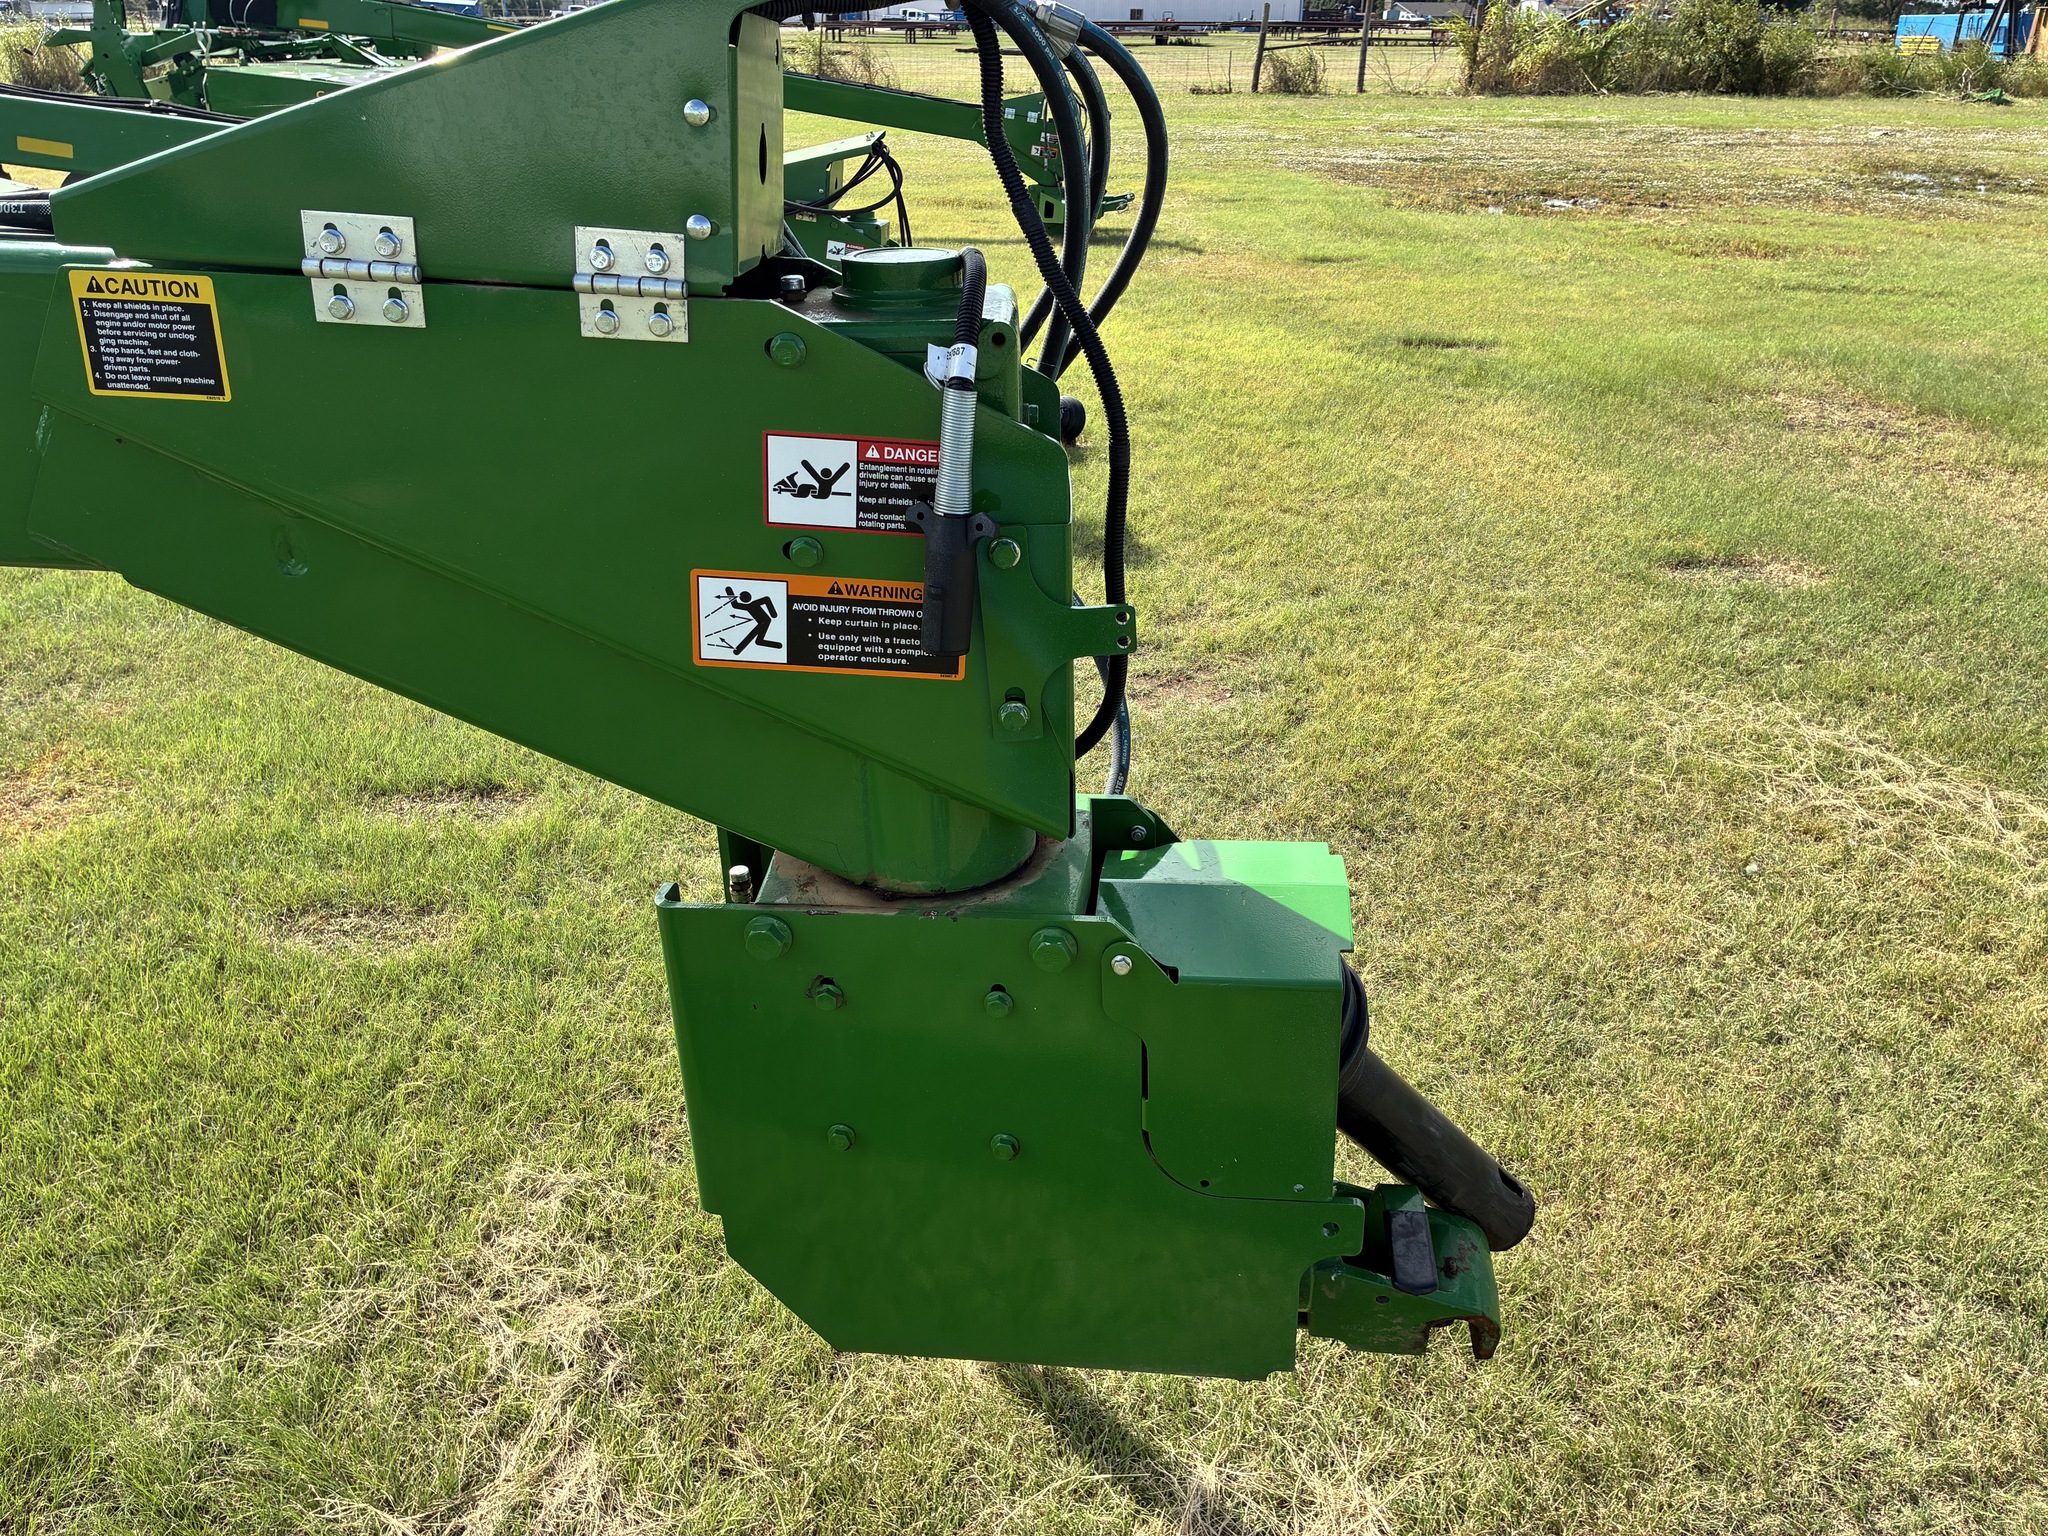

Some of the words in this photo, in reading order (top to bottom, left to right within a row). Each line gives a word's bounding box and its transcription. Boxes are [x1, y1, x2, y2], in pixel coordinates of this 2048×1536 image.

[1031, 26, 1046, 45] 4000
[1045, 47, 1055, 60] psi
[105, 278, 199, 298] CAUTION
[92, 301, 110, 310] Keep
[94, 311, 133, 319] Disengage
[169, 313, 180, 321] off
[96, 320, 121, 328] engine
[123, 320, 146, 328] and/or
[149, 322, 171, 330] motor
[173, 323, 195, 331] power
[98, 328, 121, 336] before
[123, 330, 157, 339] servicing
[169, 331, 197, 341] unclog-
[99, 337, 116, 346] ging
[118, 338, 151, 346] machine.
[100, 346, 119, 355] Keep
[121, 347, 146, 356] hands,
[148, 348, 162, 356] feet
[179, 350, 200, 358] cloth-
[102, 356, 114, 364] ing
[156, 358, 181, 366] power-
[107, 382, 151, 390] unattended.
[153, 376, 182, 385] running
[184, 377, 215, 385] machine
[884, 447, 940, 462] DANGE
[859, 463, 907, 473] Entanglement
[917, 467, 939, 475] rotatin
[859, 472, 889, 480] driveline
[859, 480, 879, 489] injury
[890, 482, 911, 490] death.
[859, 496, 876, 504] Keep
[880, 513, 906, 521] contact
[859, 520, 885, 529] rotating
[887, 522, 906, 530] parts.
[845, 583, 923, 600] WARNING
[793, 603, 818, 611] AVOID
[819, 604, 850, 613] INJURY
[852, 607, 876, 615] FROM
[878, 608, 915, 617] THROWN
[818, 617, 842, 626] Keep
[845, 619, 878, 628] curtain
[881, 621, 890, 629] in
[893, 622, 921, 631] place.
[818, 633, 836, 641] Use
[839, 634, 859, 644] only
[862, 634, 880, 643] with
[893, 636, 920, 645] tracto
[818, 643, 862, 654] equipped
[865, 644, 884, 653] with
[818, 653, 858, 663] operator
[861, 655, 909, 665] enclosure.
[1115, 774, 1124, 794] ATES
